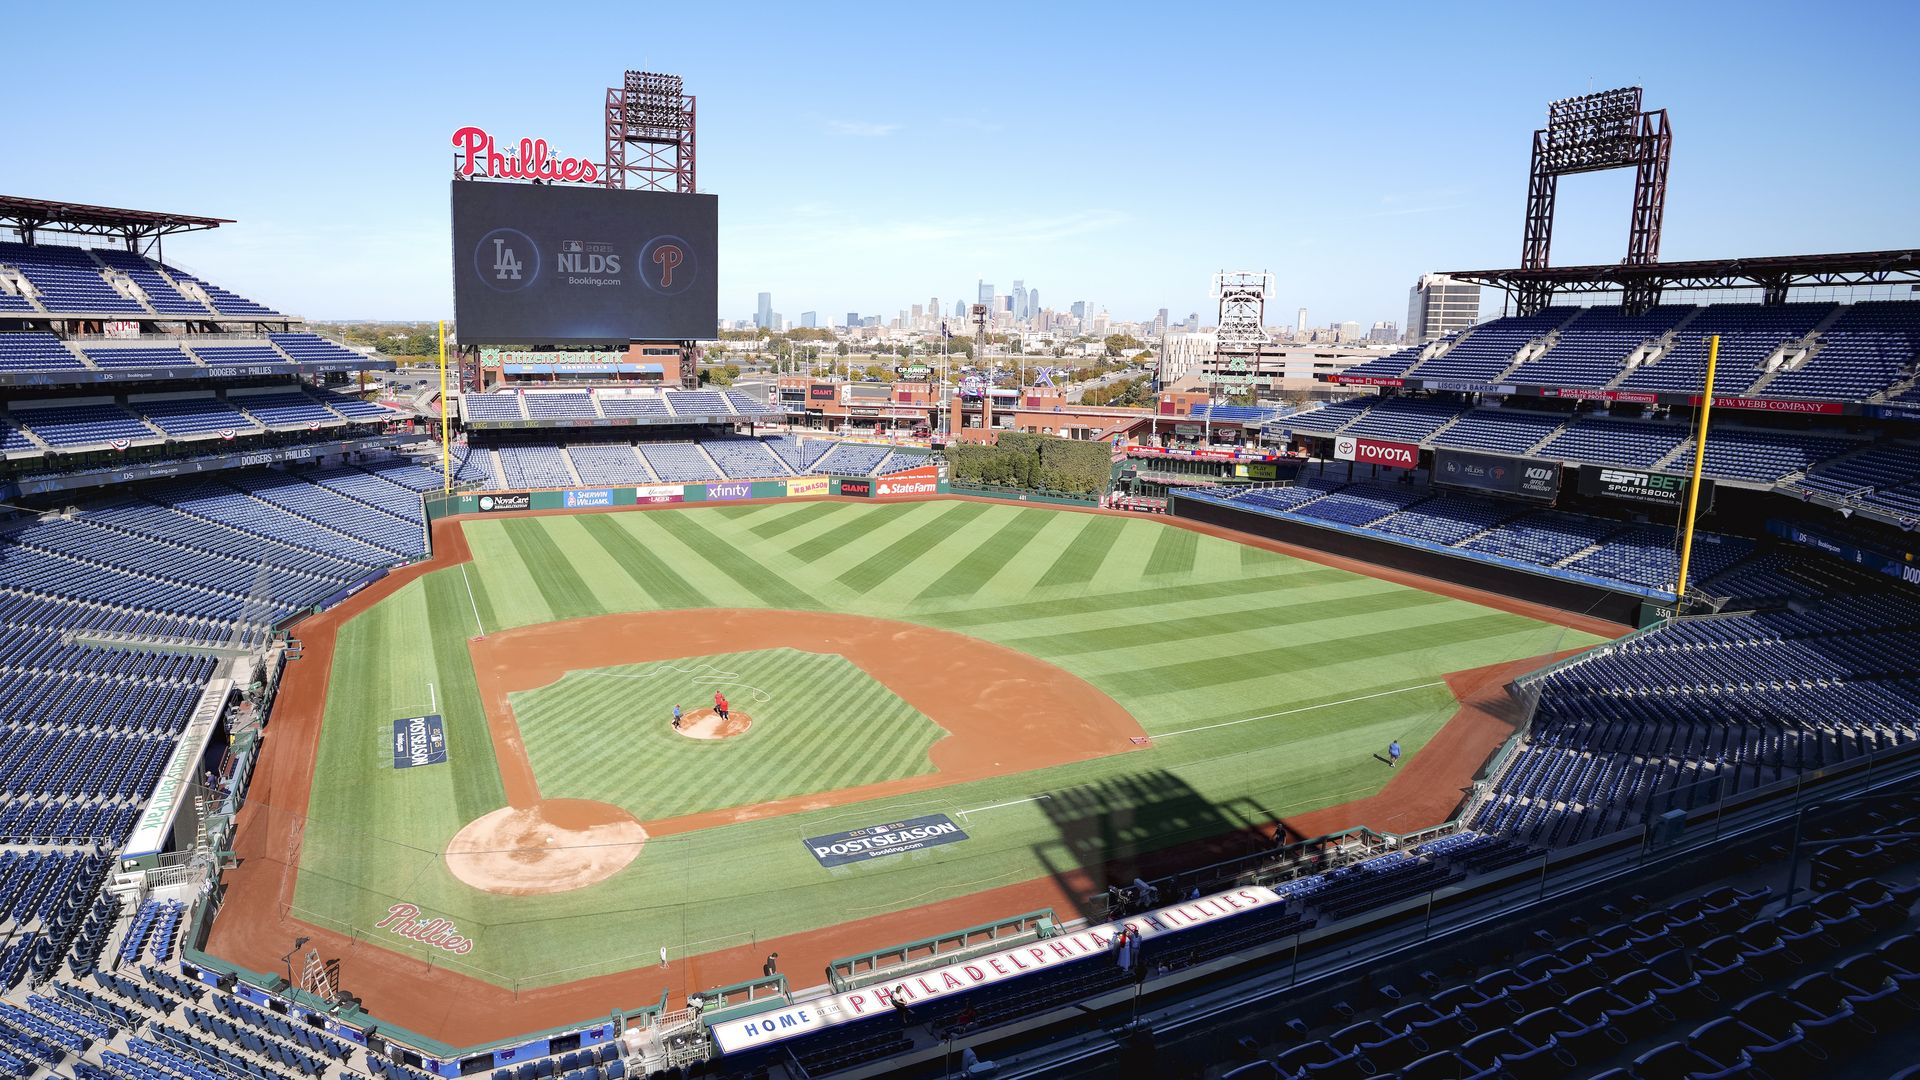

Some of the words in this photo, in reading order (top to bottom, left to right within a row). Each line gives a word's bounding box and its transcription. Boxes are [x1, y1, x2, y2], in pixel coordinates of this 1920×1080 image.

[451, 126, 598, 183] Phillies
[494, 239, 522, 280] LA
[557, 253, 621, 274] NLDS
[652, 244, 684, 288] P
[568, 276, 620, 287] Booking.com
[502, 350, 557, 364] Citizens
[558, 350, 592, 364] Bank
[594, 350, 624, 364] Park
[209, 367, 237, 377] DODGERS
[248, 366, 272, 375] PHILLIES
[1223, 384, 1248, 395] Park
[1437, 381, 1468, 390] LISCIO'S
[1469, 383, 1499, 392] BAKERY
[1718, 398, 1735, 407] F.W.
[1738, 399, 1767, 409] WEBB
[1769, 401, 1823, 412] COMPANY
[242, 453, 273, 466] DODGERS
[285, 448, 311, 460] PHILLIES
[1359, 444, 1412, 463] TOYOTA
[1525, 467, 1553, 481] KDI
[1600, 469, 1649, 487] ESPN
[1649, 475, 1689, 491] BET
[841, 484, 870, 493] GIANT
[1522, 484, 1552, 493] TECHNOLOGY
[1528, 478, 1545, 487] OFFICE
[577, 490, 608, 499] SHERWIN
[708, 484, 750, 498] xfinity
[1608, 484, 1677, 499] SPORTSBOOK
[494, 495, 530, 505] NovaCare
[1655, 607, 1672, 618] 330
[410, 717, 429, 766] POSTSEASON
[169, 744, 198, 777] Citizens
[155, 779, 178, 805] Bank
[142, 805, 173, 830] Park
[814, 822, 958, 859] POSTSEASON
[868, 842, 924, 858] Booking.com
[374, 903, 473, 955] Phillies
[744, 1009, 811, 1038] HOME
[816, 1008, 826, 1016] OF
[828, 1004, 841, 1014] THE
[848, 931, 1111, 1014] PHILADELPHIA
[1122, 889, 1260, 935] PHILLIES
